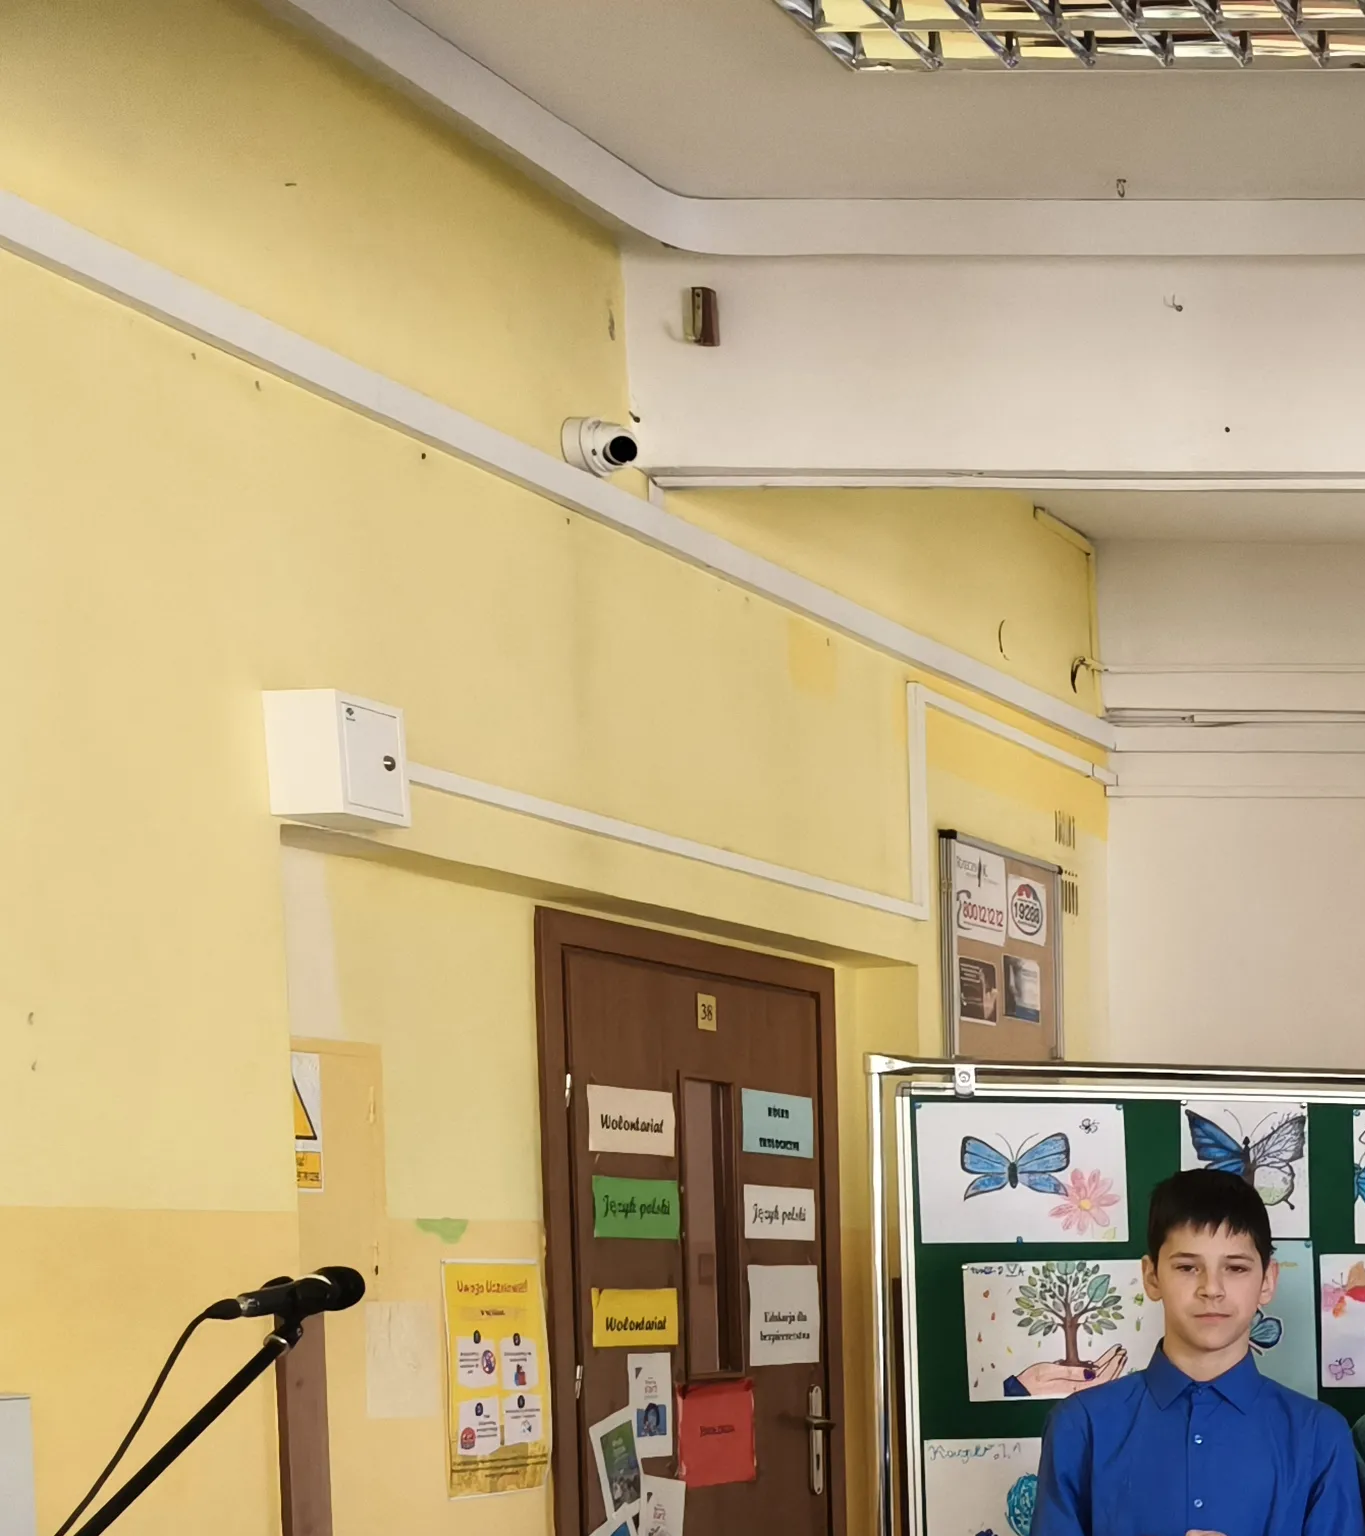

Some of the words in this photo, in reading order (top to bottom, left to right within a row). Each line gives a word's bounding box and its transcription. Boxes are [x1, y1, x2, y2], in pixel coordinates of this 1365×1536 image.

[700, 1003, 713, 1021] 38
[600, 1113, 664, 1134] Wolontariat
[605, 1315, 667, 1332] Wolontariat
